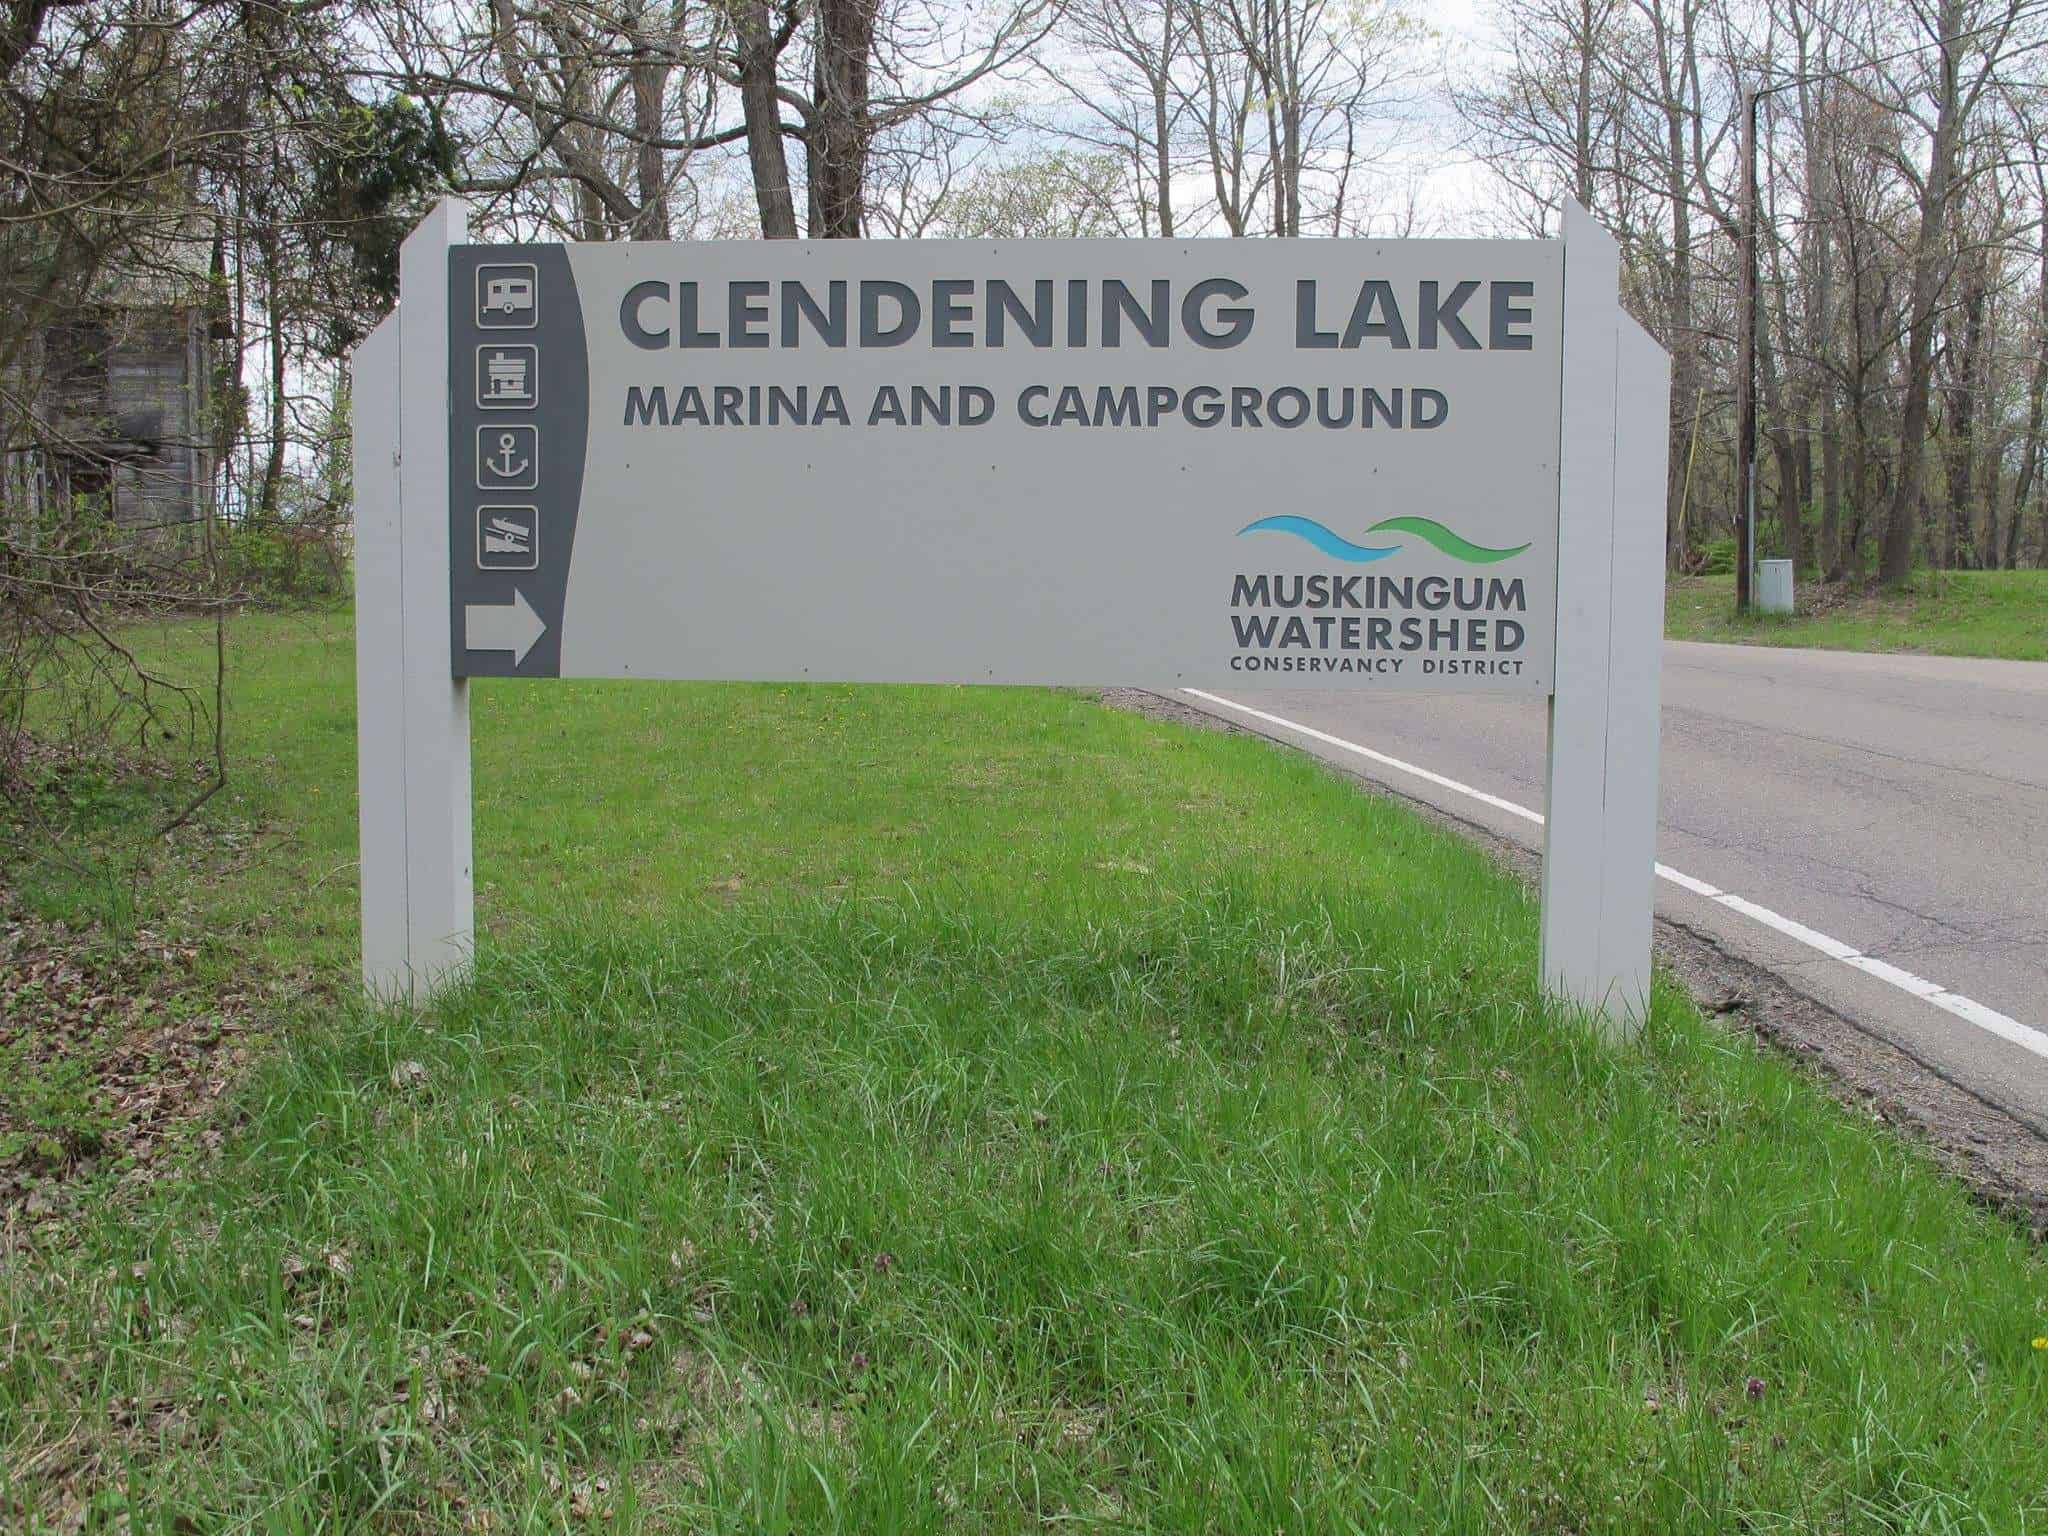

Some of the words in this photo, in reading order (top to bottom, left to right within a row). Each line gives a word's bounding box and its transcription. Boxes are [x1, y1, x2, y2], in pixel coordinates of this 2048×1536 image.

[620, 278, 1255, 350] CLENDENING
[1296, 280, 1533, 350] LAKE
[624, 386, 851, 426] MARINA
[867, 386, 995, 426] AND
[1018, 385, 1448, 429] CAMPGROUND
[1231, 575, 1526, 611] MUSKINGUM
[1231, 616, 1524, 652] WATERSHED
[1231, 656, 1403, 673] CONSERVANCY
[1423, 660, 1523, 675] DISTRICT
